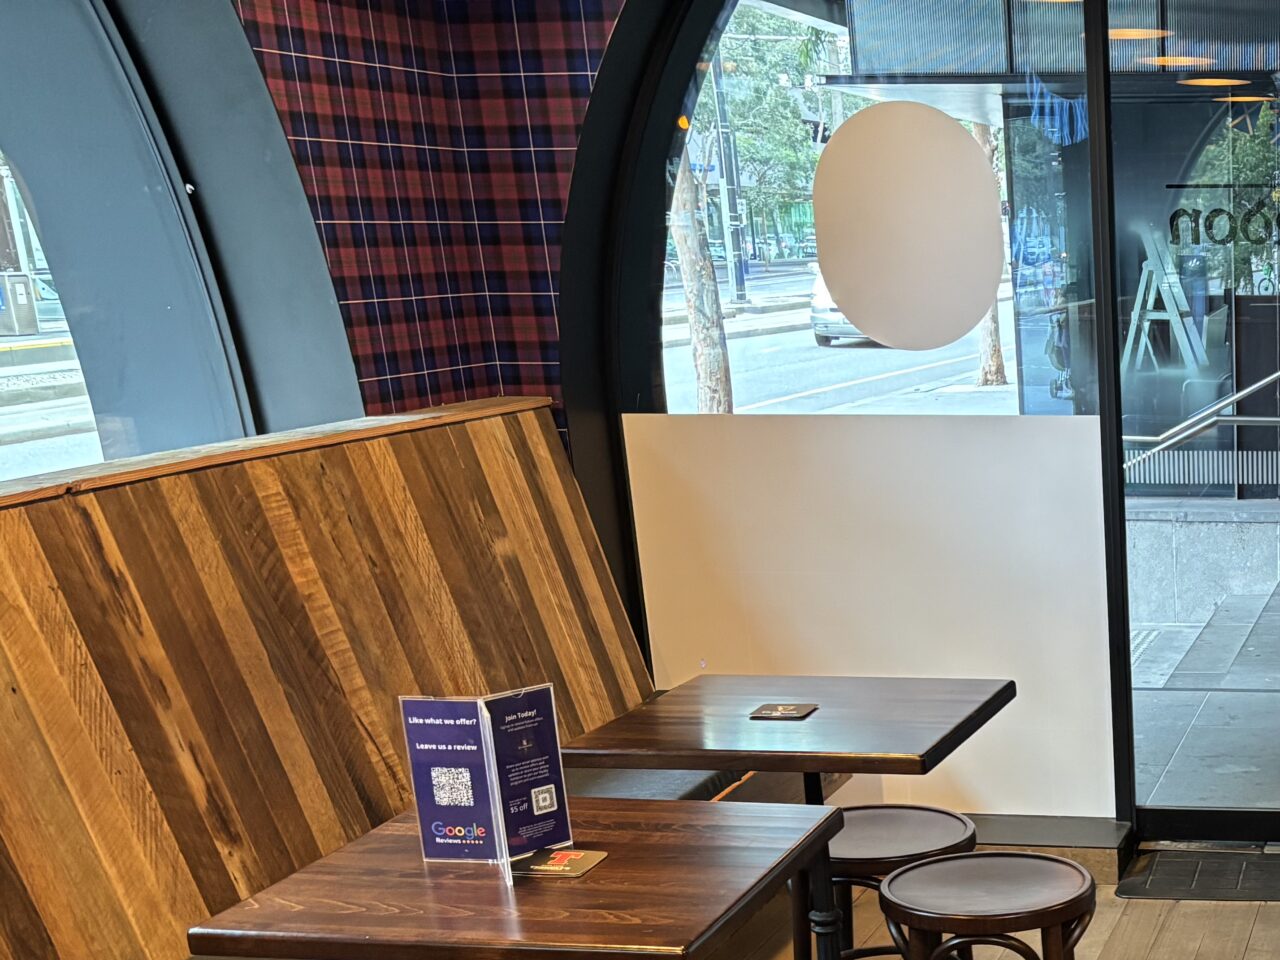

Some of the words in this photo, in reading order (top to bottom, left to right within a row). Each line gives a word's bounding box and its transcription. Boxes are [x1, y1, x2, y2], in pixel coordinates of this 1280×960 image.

[408, 716, 423, 724] Like
[424, 717, 443, 725] what
[505, 713, 517, 723] Join
[517, 709, 537, 719] Today!
[416, 742, 437, 750] Leave
[453, 743, 477, 751] review
[510, 805, 519, 814] $5
[519, 802, 529, 812] off
[431, 821, 486, 840] Google
[435, 836, 462, 844] Reviews
